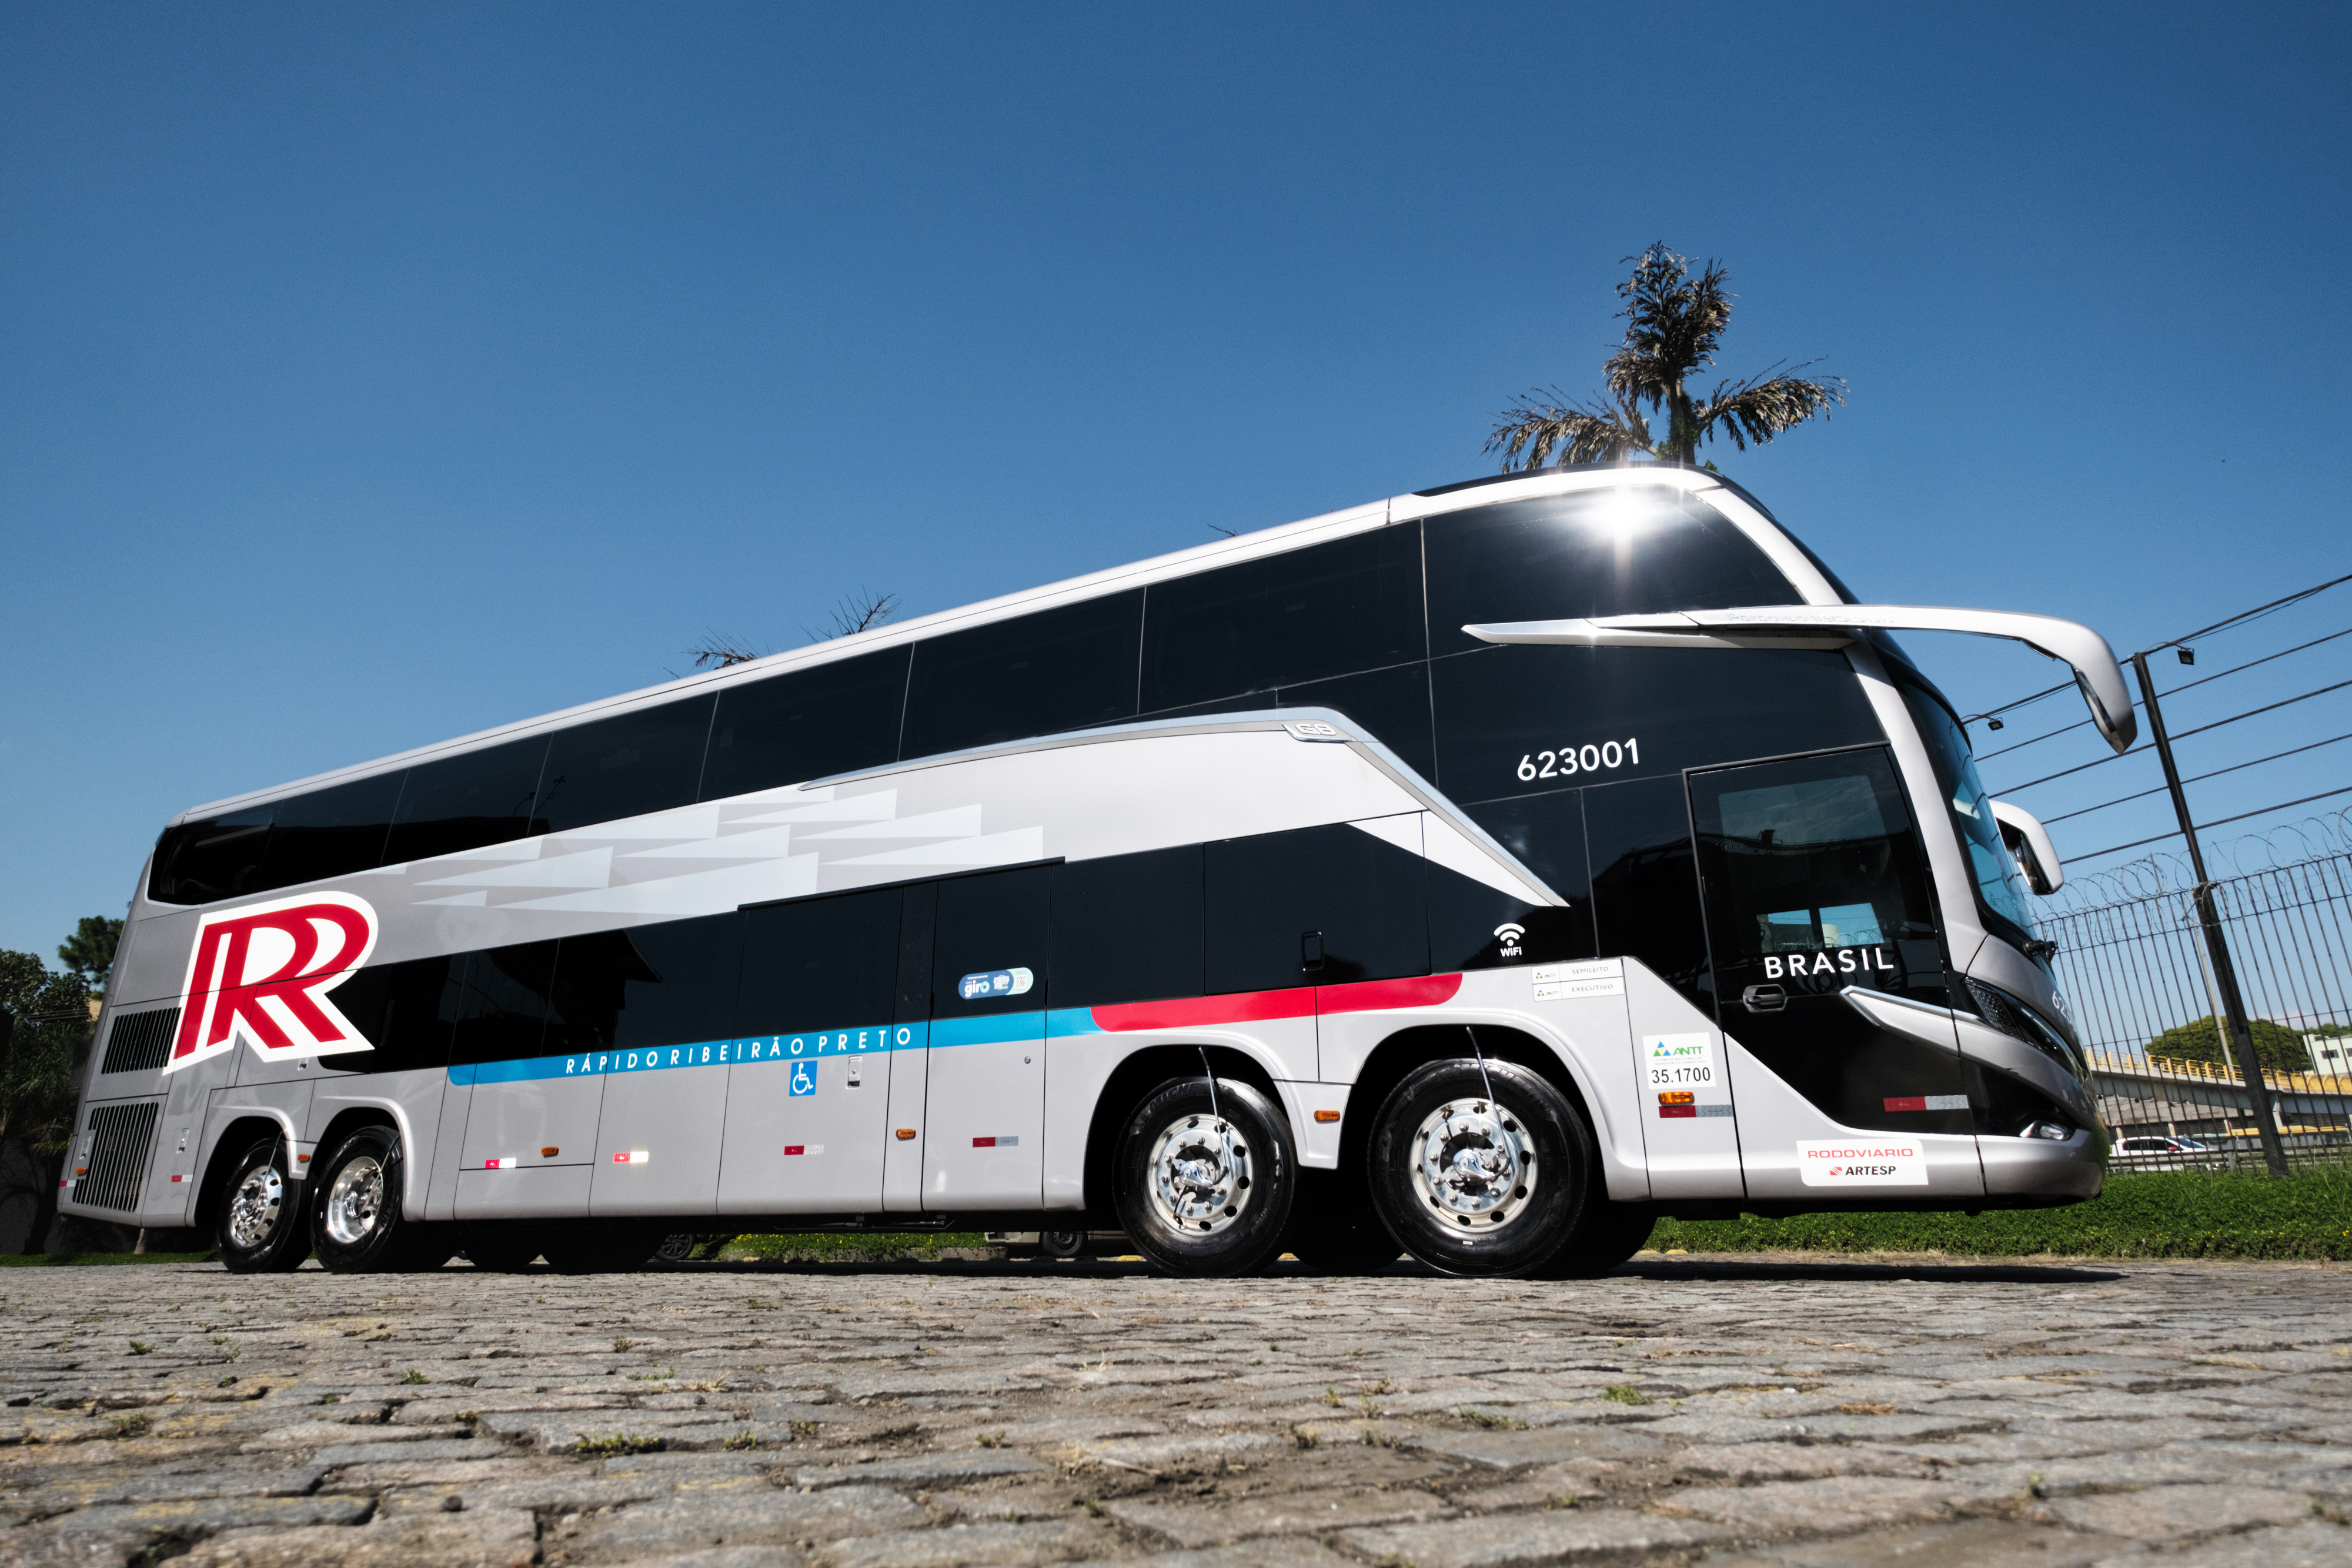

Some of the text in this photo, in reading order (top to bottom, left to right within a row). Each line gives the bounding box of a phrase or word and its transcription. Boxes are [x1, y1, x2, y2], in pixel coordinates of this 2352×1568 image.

[1295, 723, 1337, 736] G8
[1517, 738, 1639, 781] 623001
[1500, 947, 1522, 957] WiFi
[1764, 947, 1894, 978] BRASIL
[1572, 966, 1609, 975] SEMILEITO
[964, 979, 990, 998] giro
[1572, 984, 1613, 992] EXECUTIVO
[566, 1028, 911, 1074] RÁPIDO RIBEIRÃO PRETO
[1673, 1046, 1703, 1055] ANTT
[1651, 1066, 1710, 1084] 35.1700
[1808, 1147, 1913, 1158] RODOVIÁRIO
[1845, 1166, 1896, 1176] ARTESP
